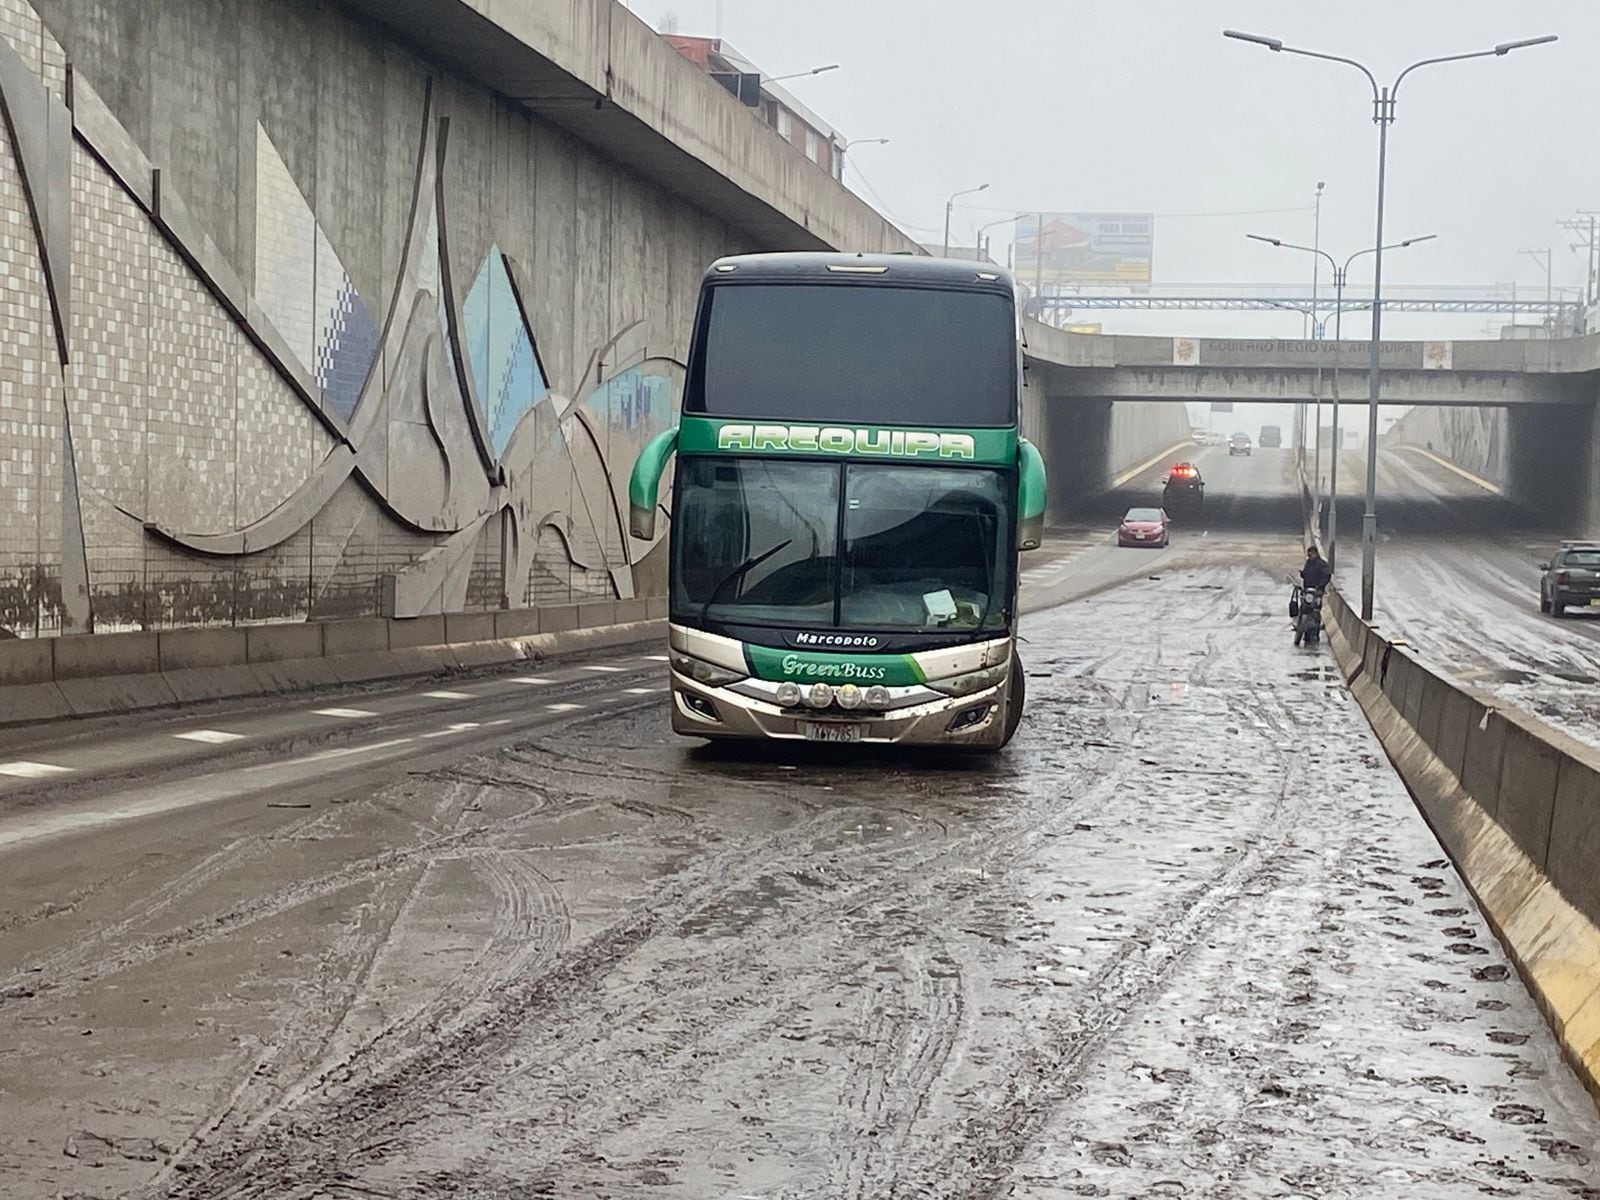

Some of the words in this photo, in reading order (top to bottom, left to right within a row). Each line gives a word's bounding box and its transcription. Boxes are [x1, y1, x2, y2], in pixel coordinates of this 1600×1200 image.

[1209, 341, 1274, 352] GOBIERNO
[718, 425, 975, 459] AREQUIPA
[796, 633, 878, 646] Marcopolo
